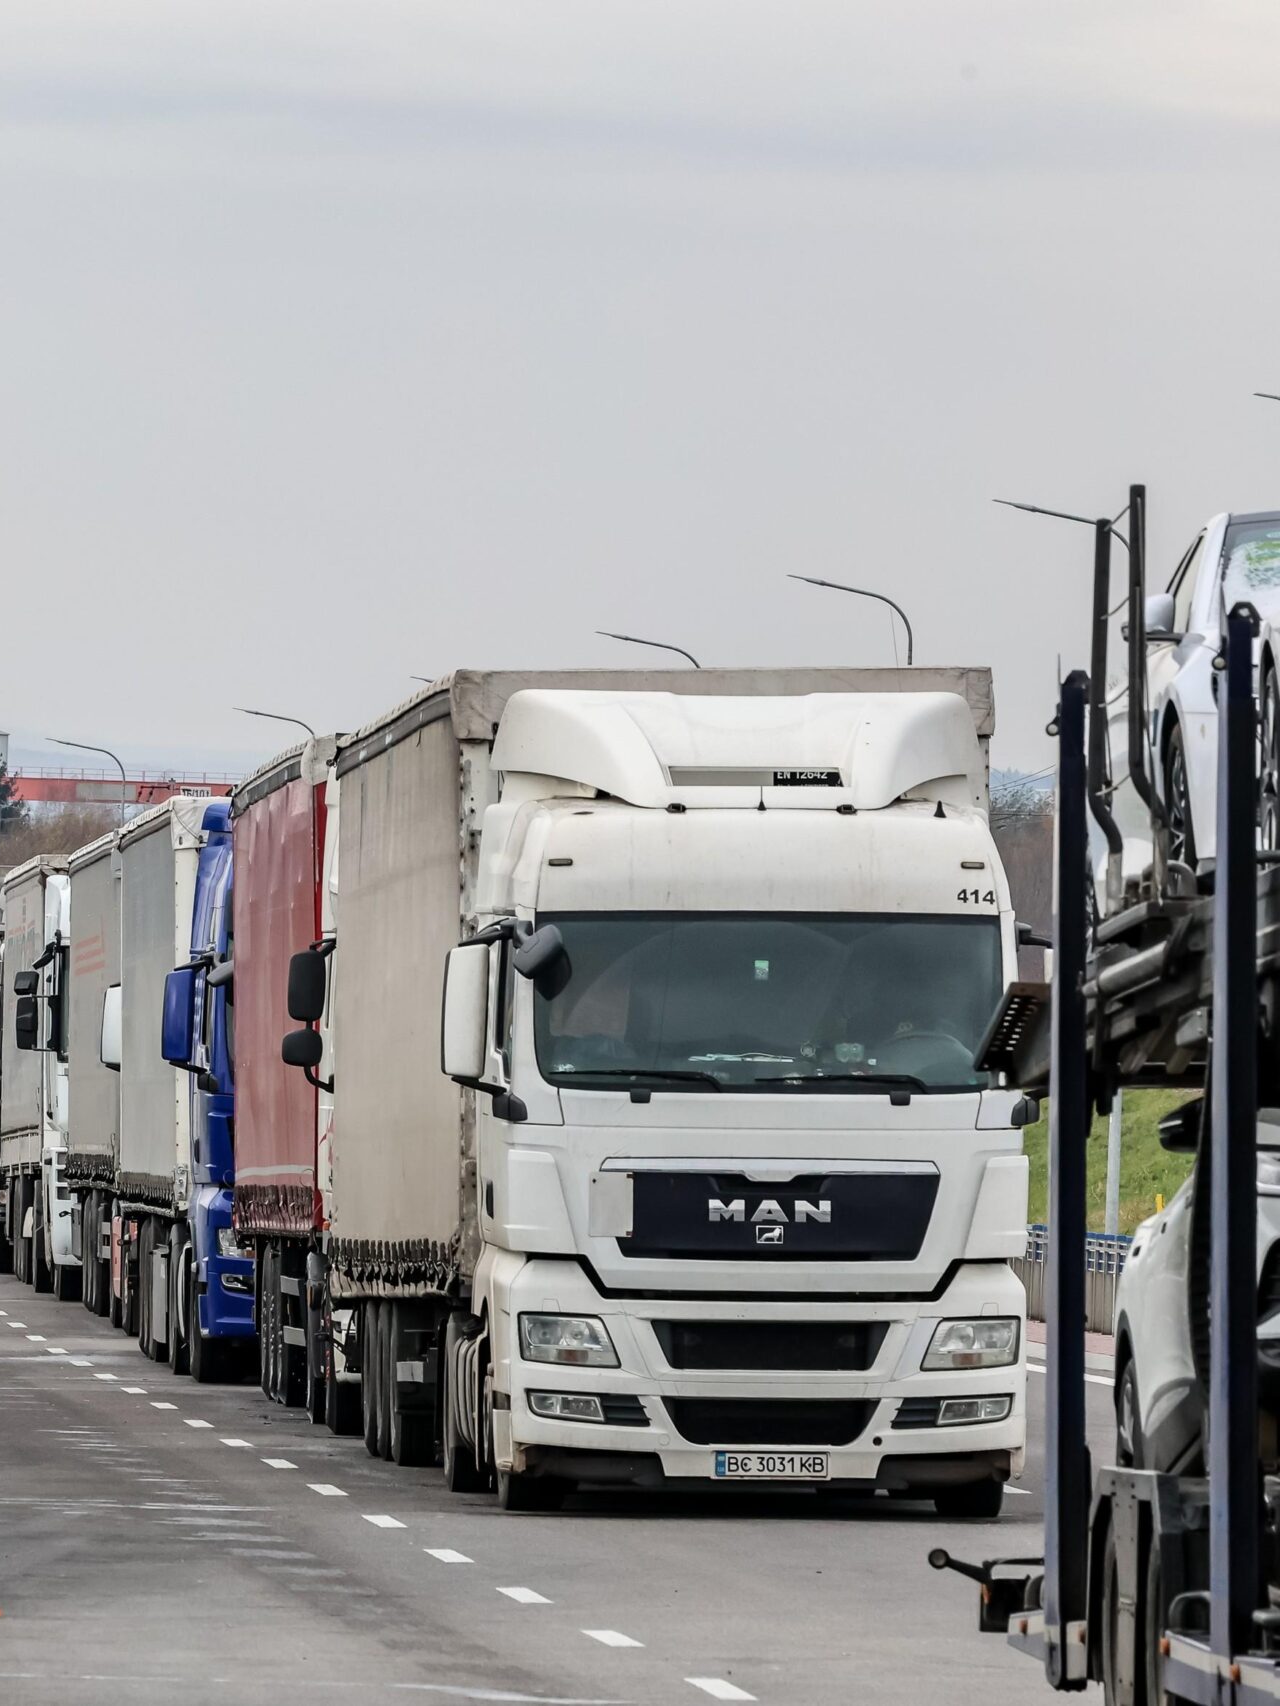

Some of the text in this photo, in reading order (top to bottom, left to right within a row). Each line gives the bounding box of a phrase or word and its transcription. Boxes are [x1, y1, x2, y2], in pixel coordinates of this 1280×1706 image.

[777, 771, 828, 779] EN 12642
[957, 888, 996, 905] 414
[708, 1199, 832, 1223] MAN
[727, 1456, 752, 1473] BC
[756, 1456, 795, 1473] 3031
[800, 1456, 825, 1473] KB
